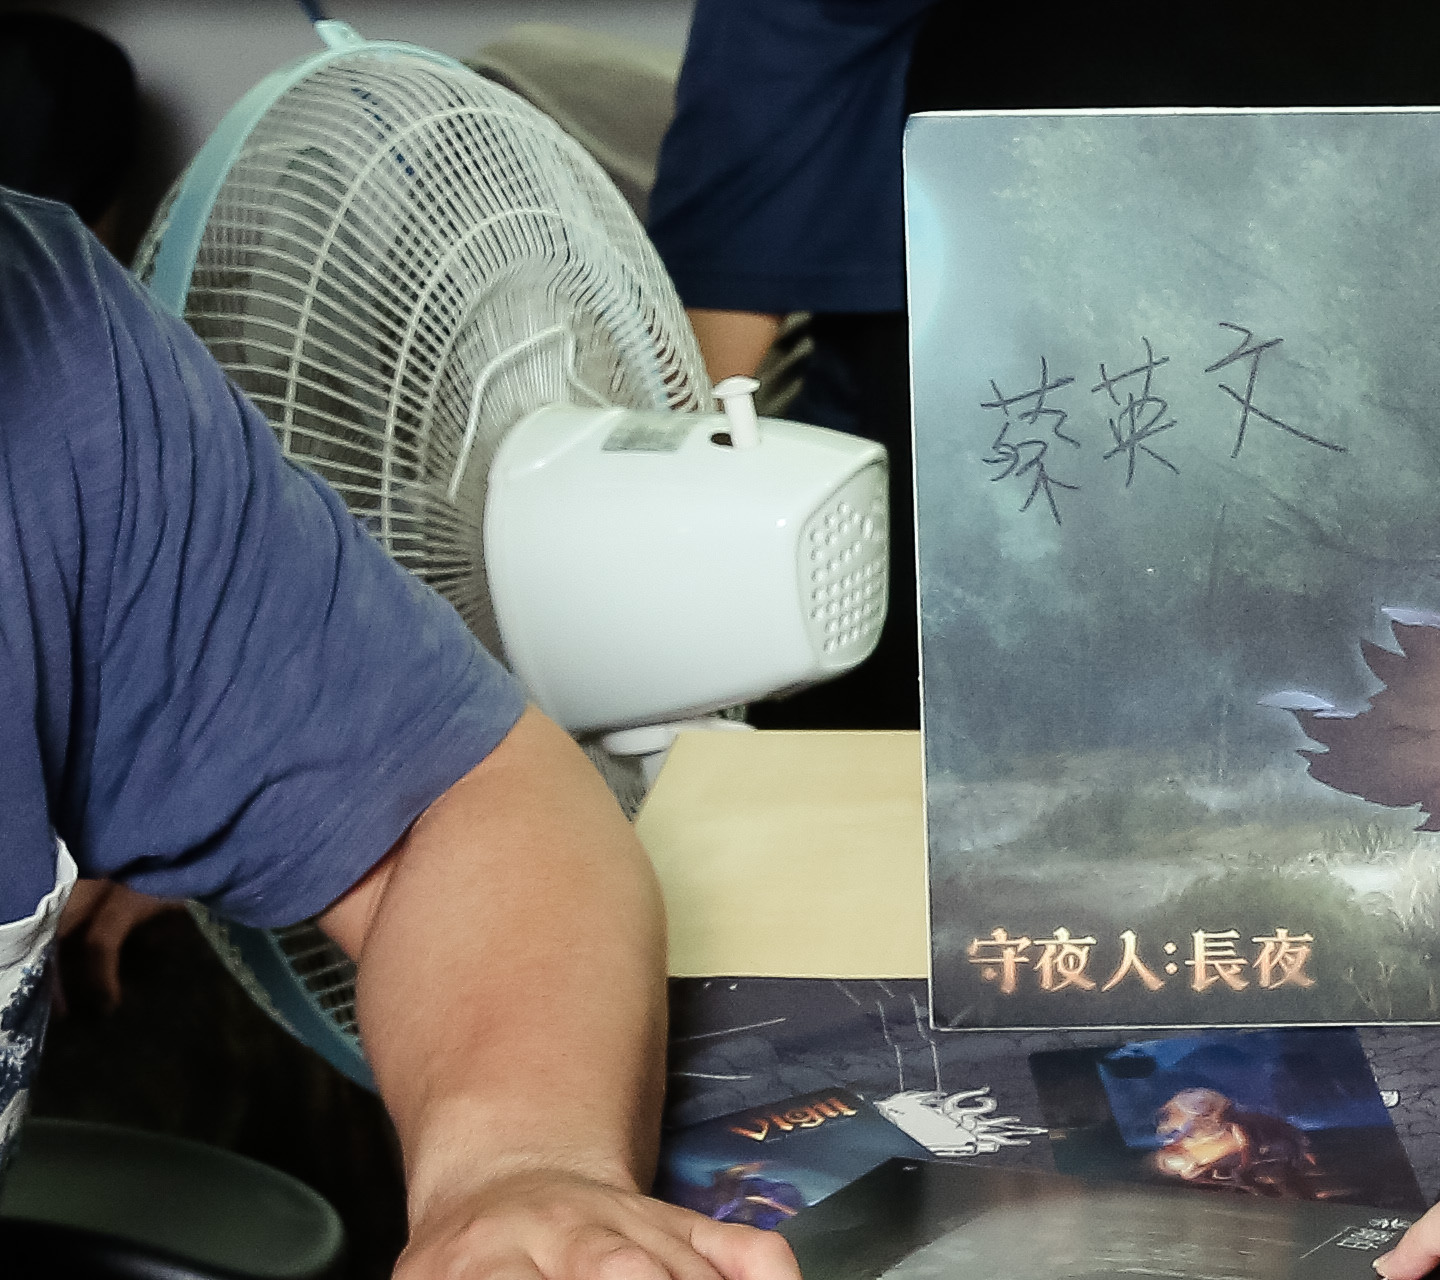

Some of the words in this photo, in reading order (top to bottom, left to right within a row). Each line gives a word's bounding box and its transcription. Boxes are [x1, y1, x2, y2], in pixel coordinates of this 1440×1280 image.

[979, 322, 1348, 526] 蔡英文
[968, 926, 1316, 994] 守夜人:長夜
